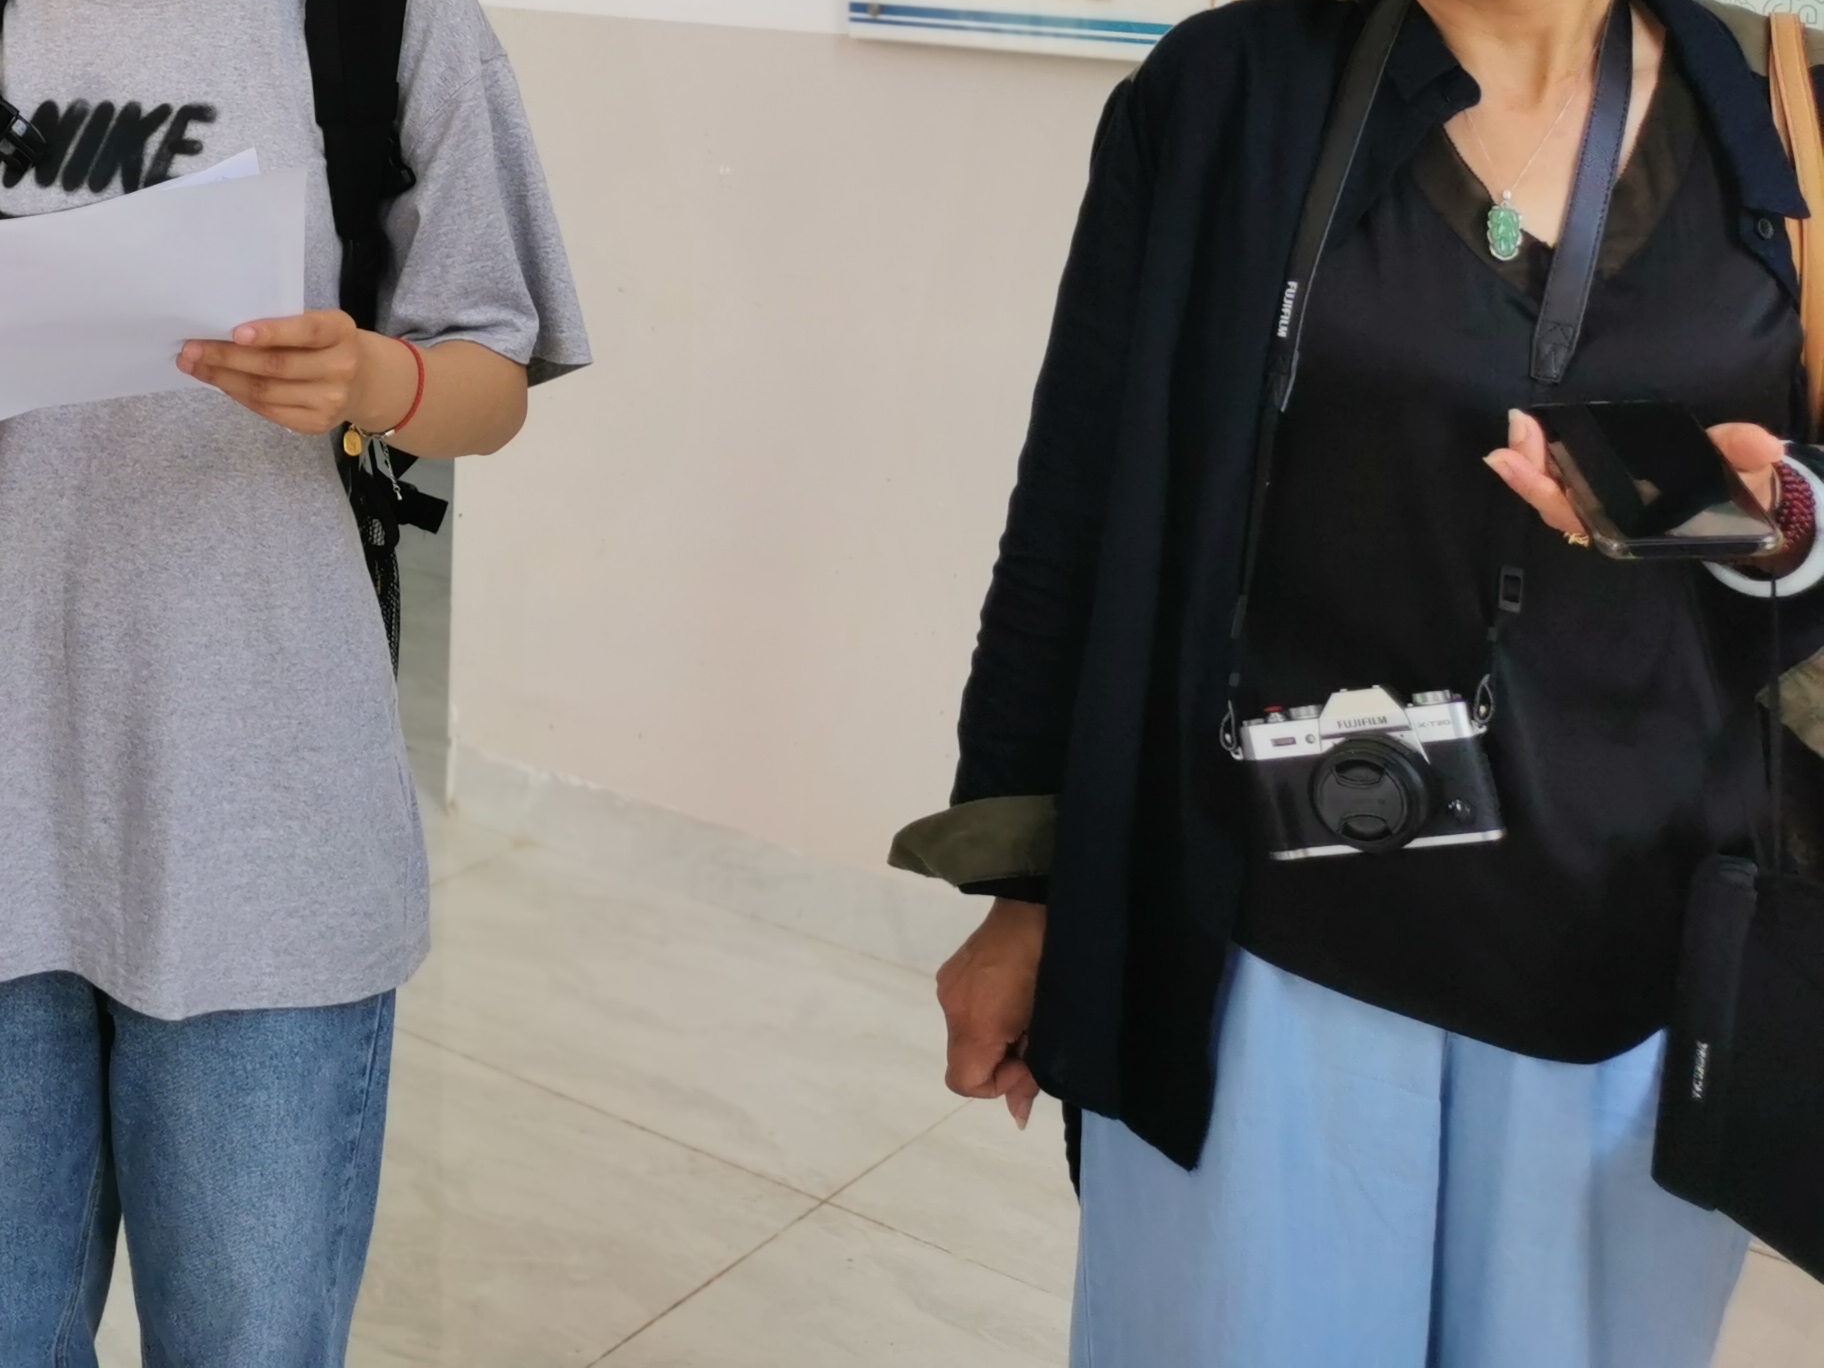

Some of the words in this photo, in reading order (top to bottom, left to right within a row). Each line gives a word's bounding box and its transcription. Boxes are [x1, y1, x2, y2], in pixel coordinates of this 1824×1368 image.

[2, 99, 217, 194] NIKE
[1277, 280, 1298, 338] FUJIFILM
[1336, 716, 1388, 729] FUJIFILM
